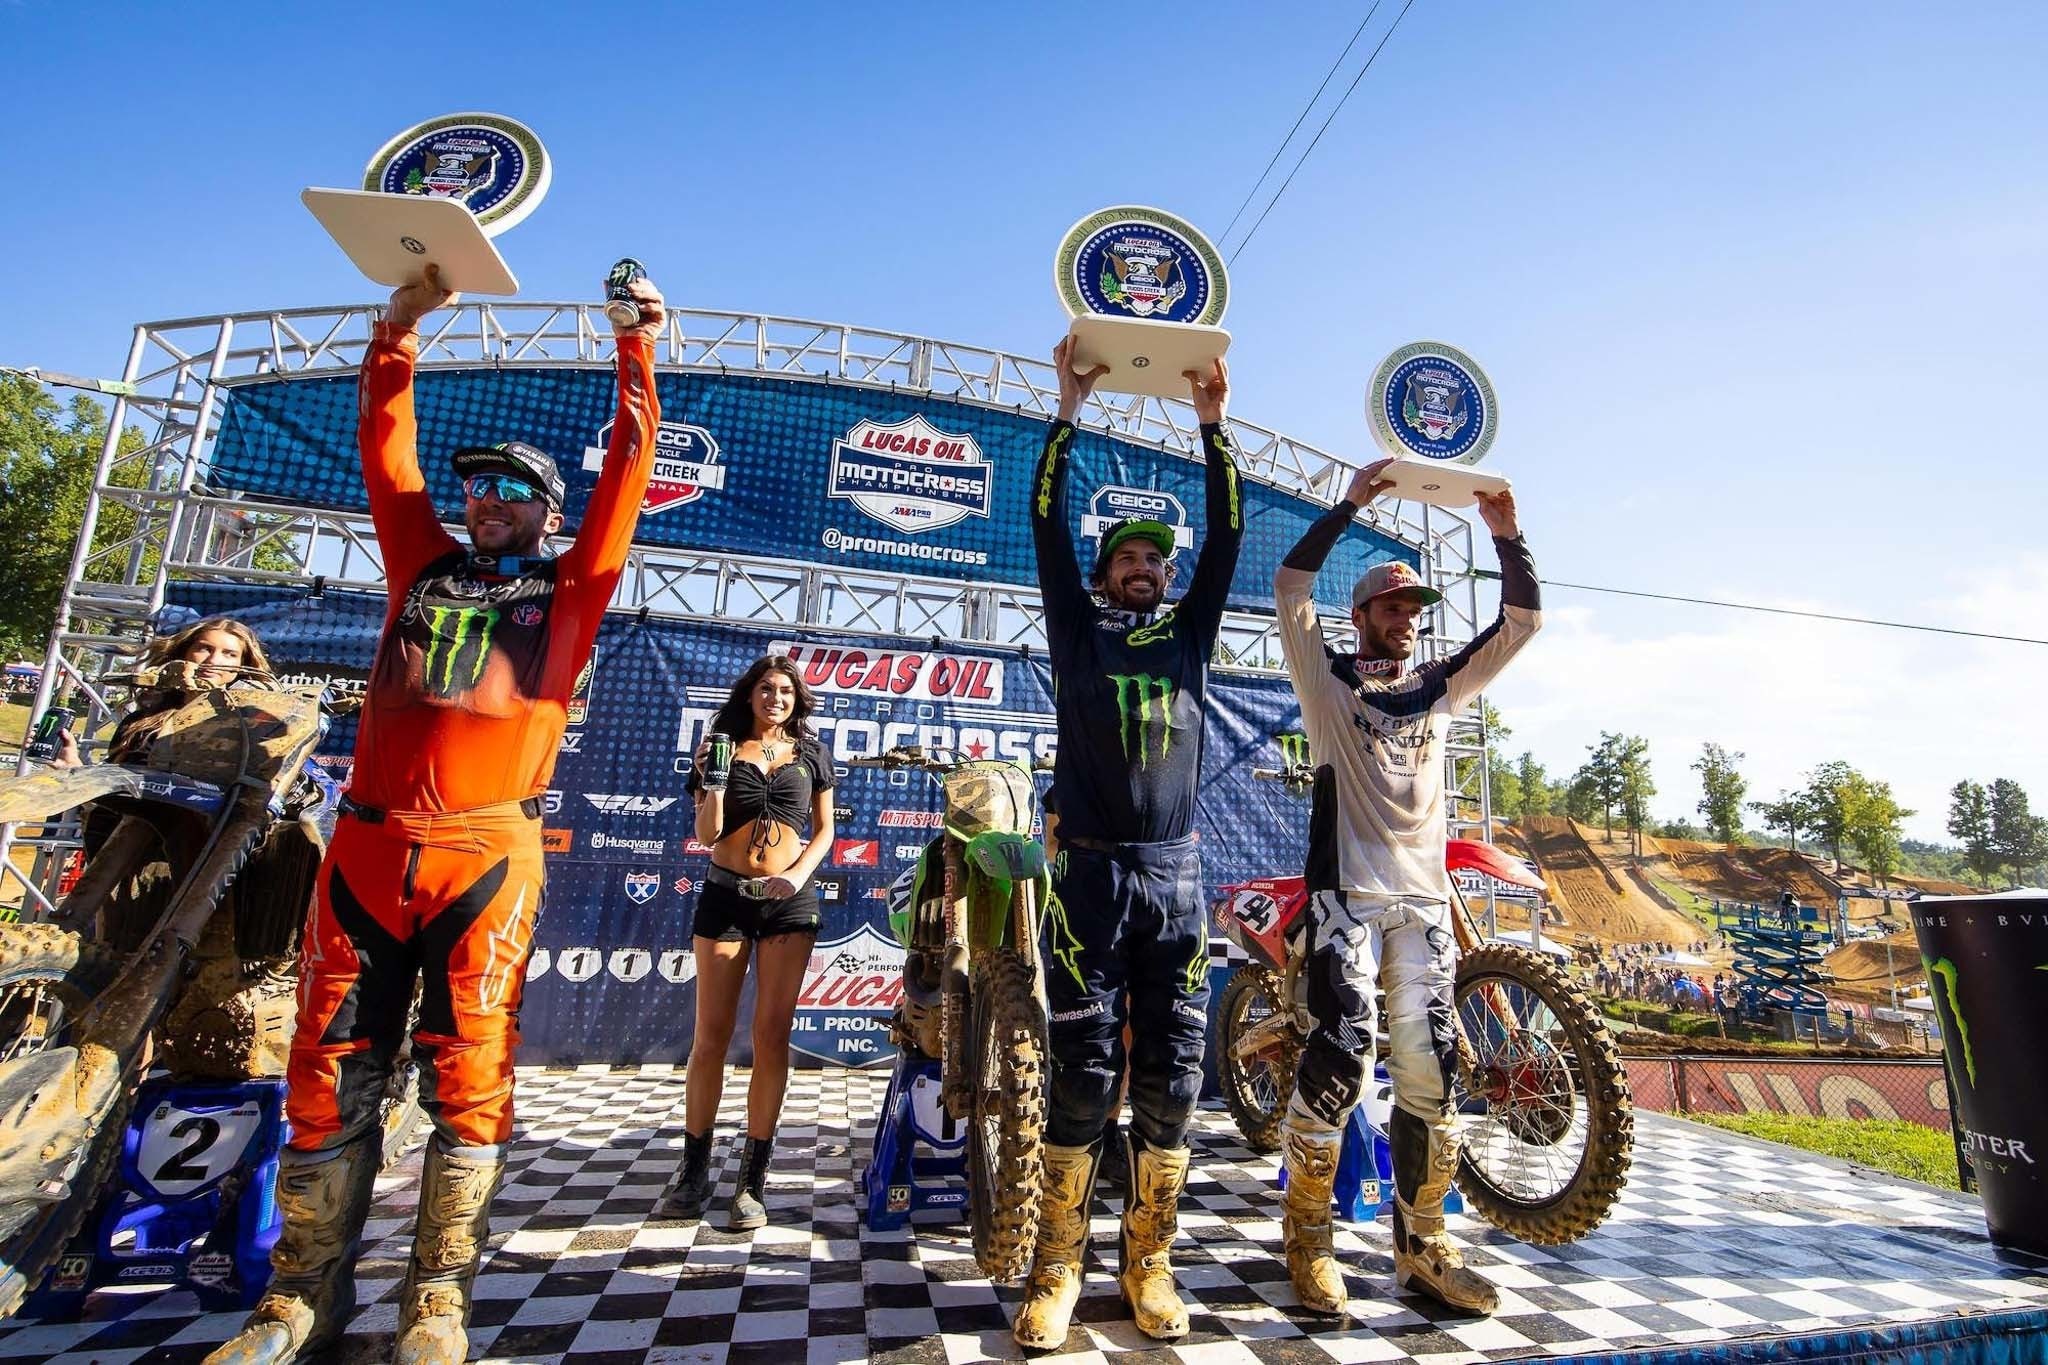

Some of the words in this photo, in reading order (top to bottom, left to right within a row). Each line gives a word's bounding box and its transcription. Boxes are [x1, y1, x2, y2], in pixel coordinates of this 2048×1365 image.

[862, 430, 931, 456] LUCAS
[933, 441, 967, 461] OIL
[653, 462, 700, 481] CREEK
[839, 461, 984, 495] MOTOCROSS
[894, 462, 933, 473] PRO
[838, 476, 983, 502] CHAMPIONSHIP
[1108, 492, 1167, 511] GEICO
[822, 527, 988, 566] @promotocross
[928, 654, 994, 700] OIL
[833, 697, 935, 720] PRO
[582, 793, 678, 812] FLY
[600, 809, 656, 817] RACING
[605, 836, 664, 850] Husqvarna
[838, 1038, 879, 1053] INC.
[153, 1116, 220, 1180] 2
